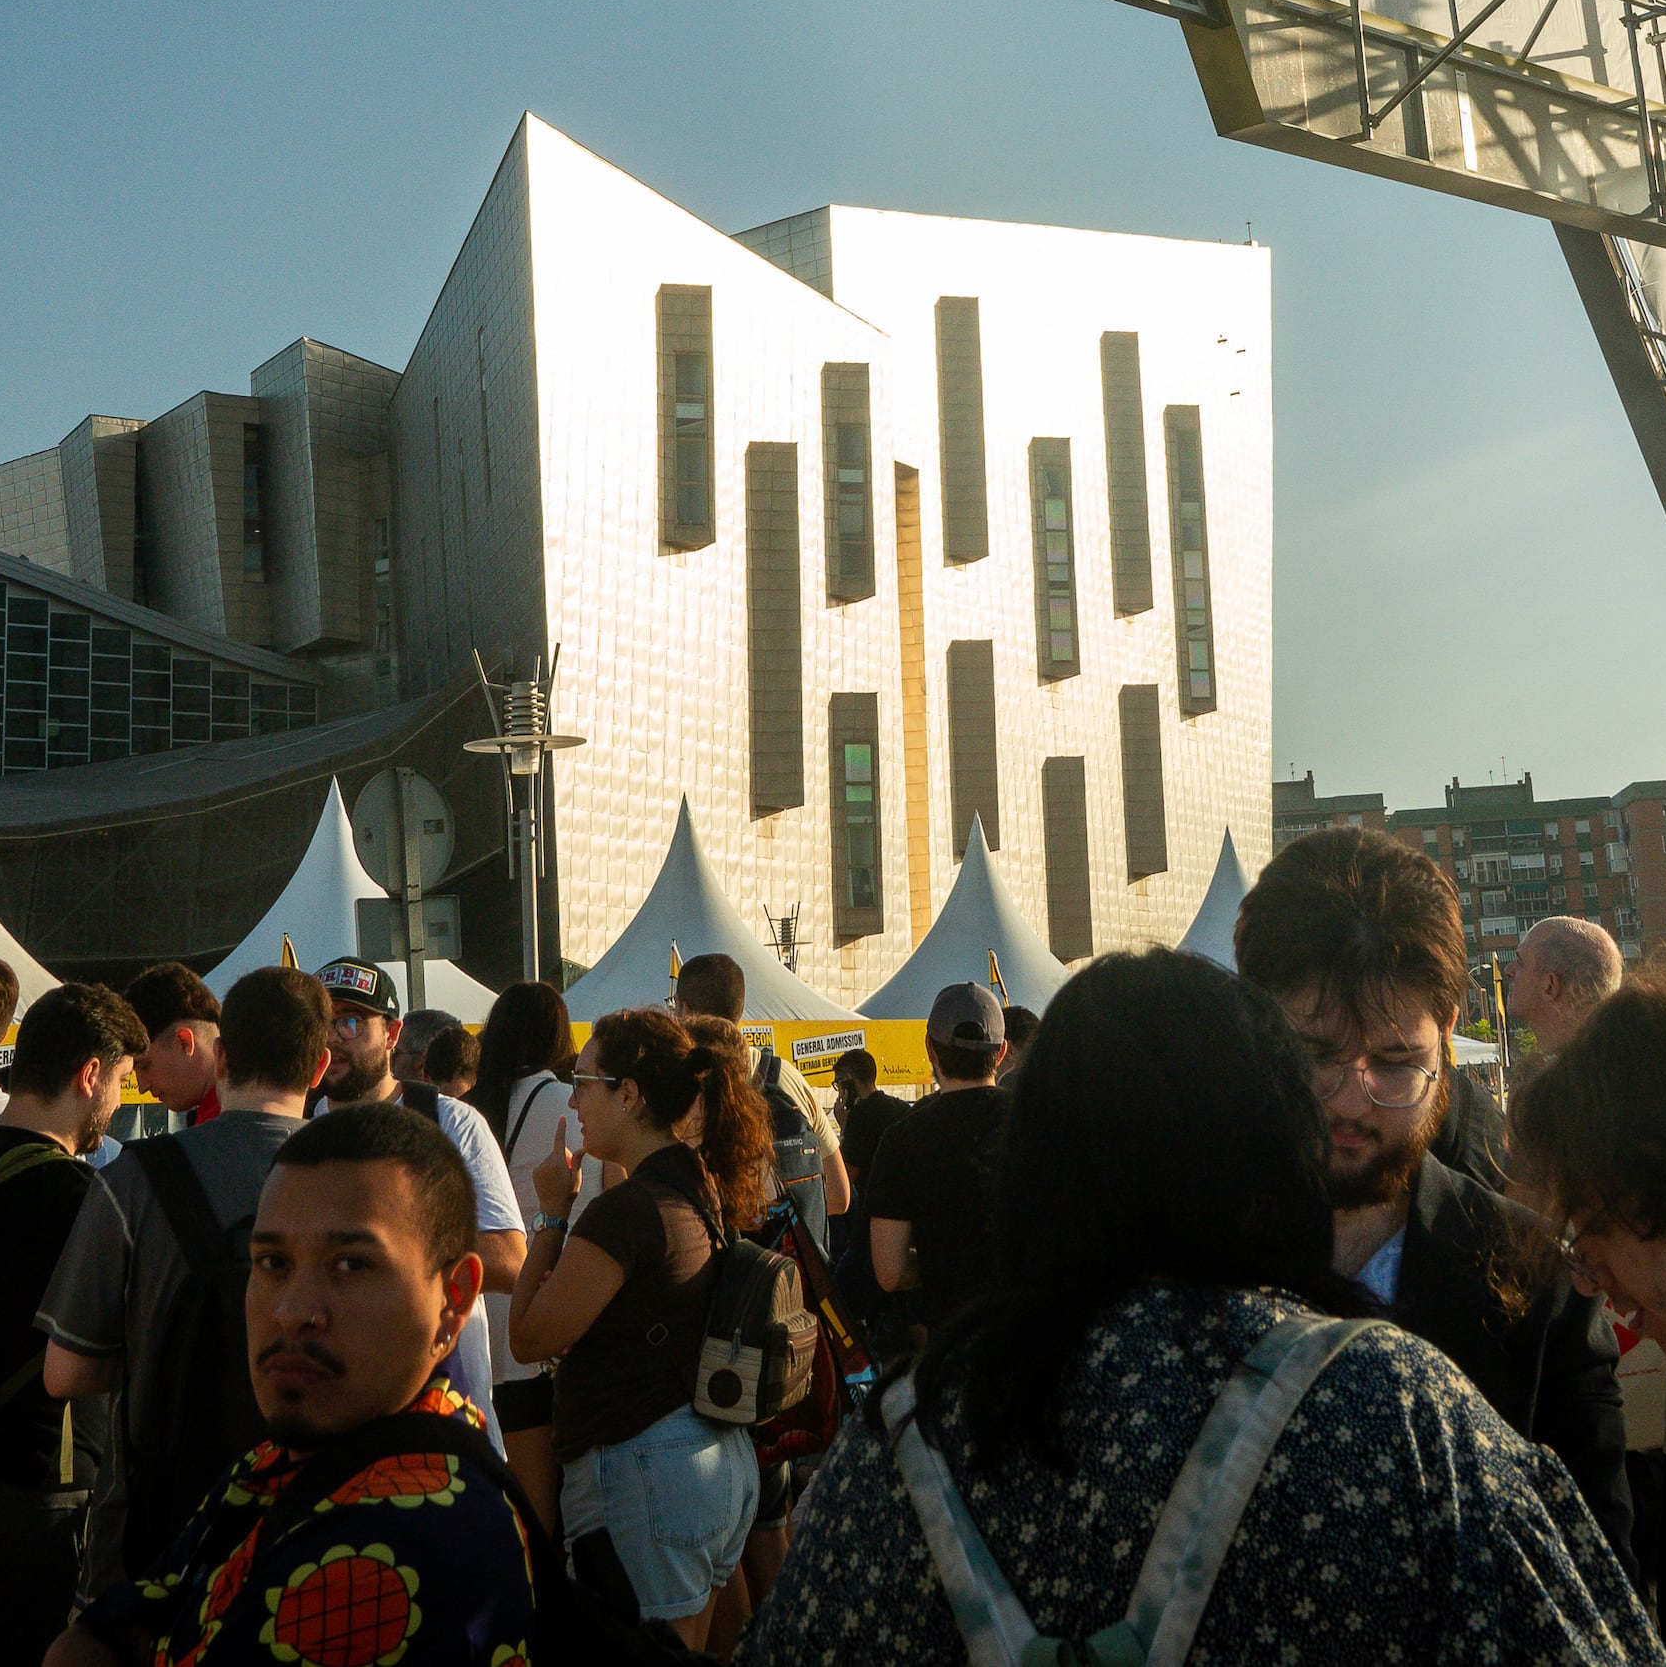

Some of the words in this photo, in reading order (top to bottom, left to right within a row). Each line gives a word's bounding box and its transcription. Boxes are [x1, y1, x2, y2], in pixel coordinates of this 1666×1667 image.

[754, 1033, 772, 1046] CON
[796, 1039, 825, 1056] GENERAL
[826, 1033, 863, 1051] ADMISSION
[799, 1059, 821, 1072] ENTRADA
